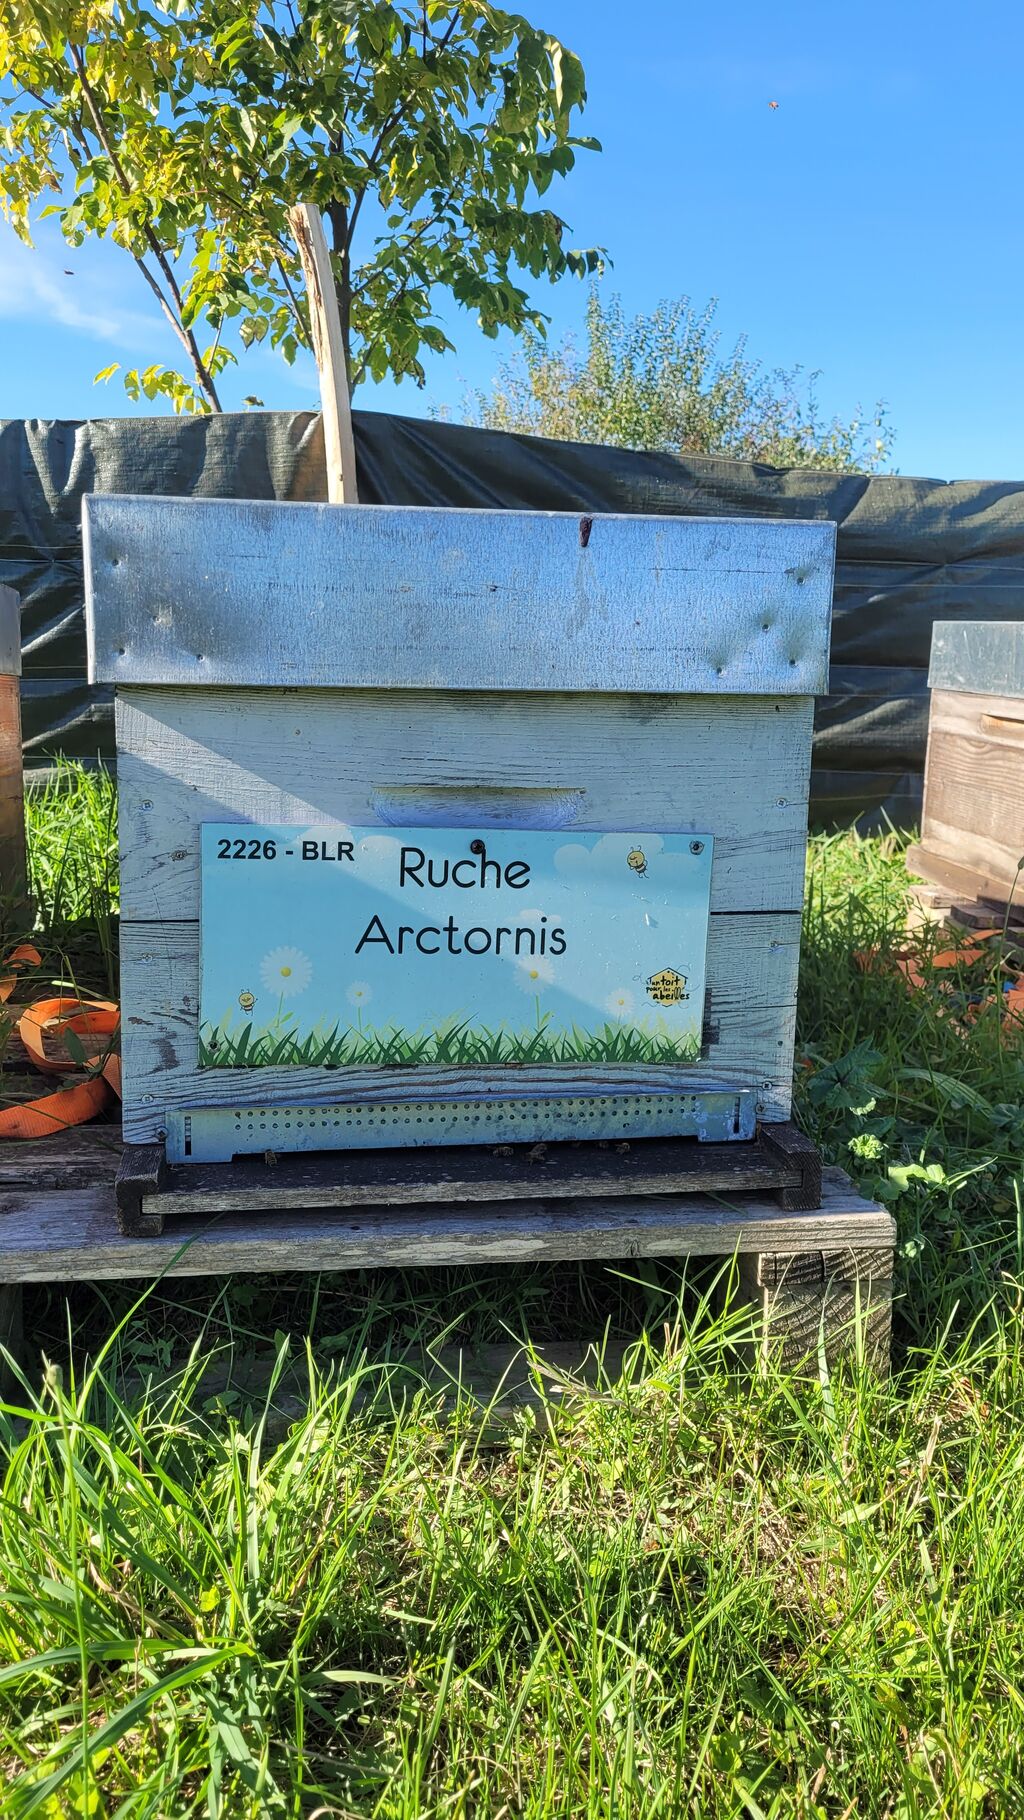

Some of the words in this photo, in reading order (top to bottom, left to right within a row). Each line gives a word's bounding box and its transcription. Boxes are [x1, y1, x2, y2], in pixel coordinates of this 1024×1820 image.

[217, 838, 277, 861] 2226
[302, 840, 355, 862] BLR
[399, 846, 531, 889] Ruche
[354, 914, 567, 956] Arctornis
[660, 975, 681, 986] toit
[652, 986, 690, 1000] abeilles
